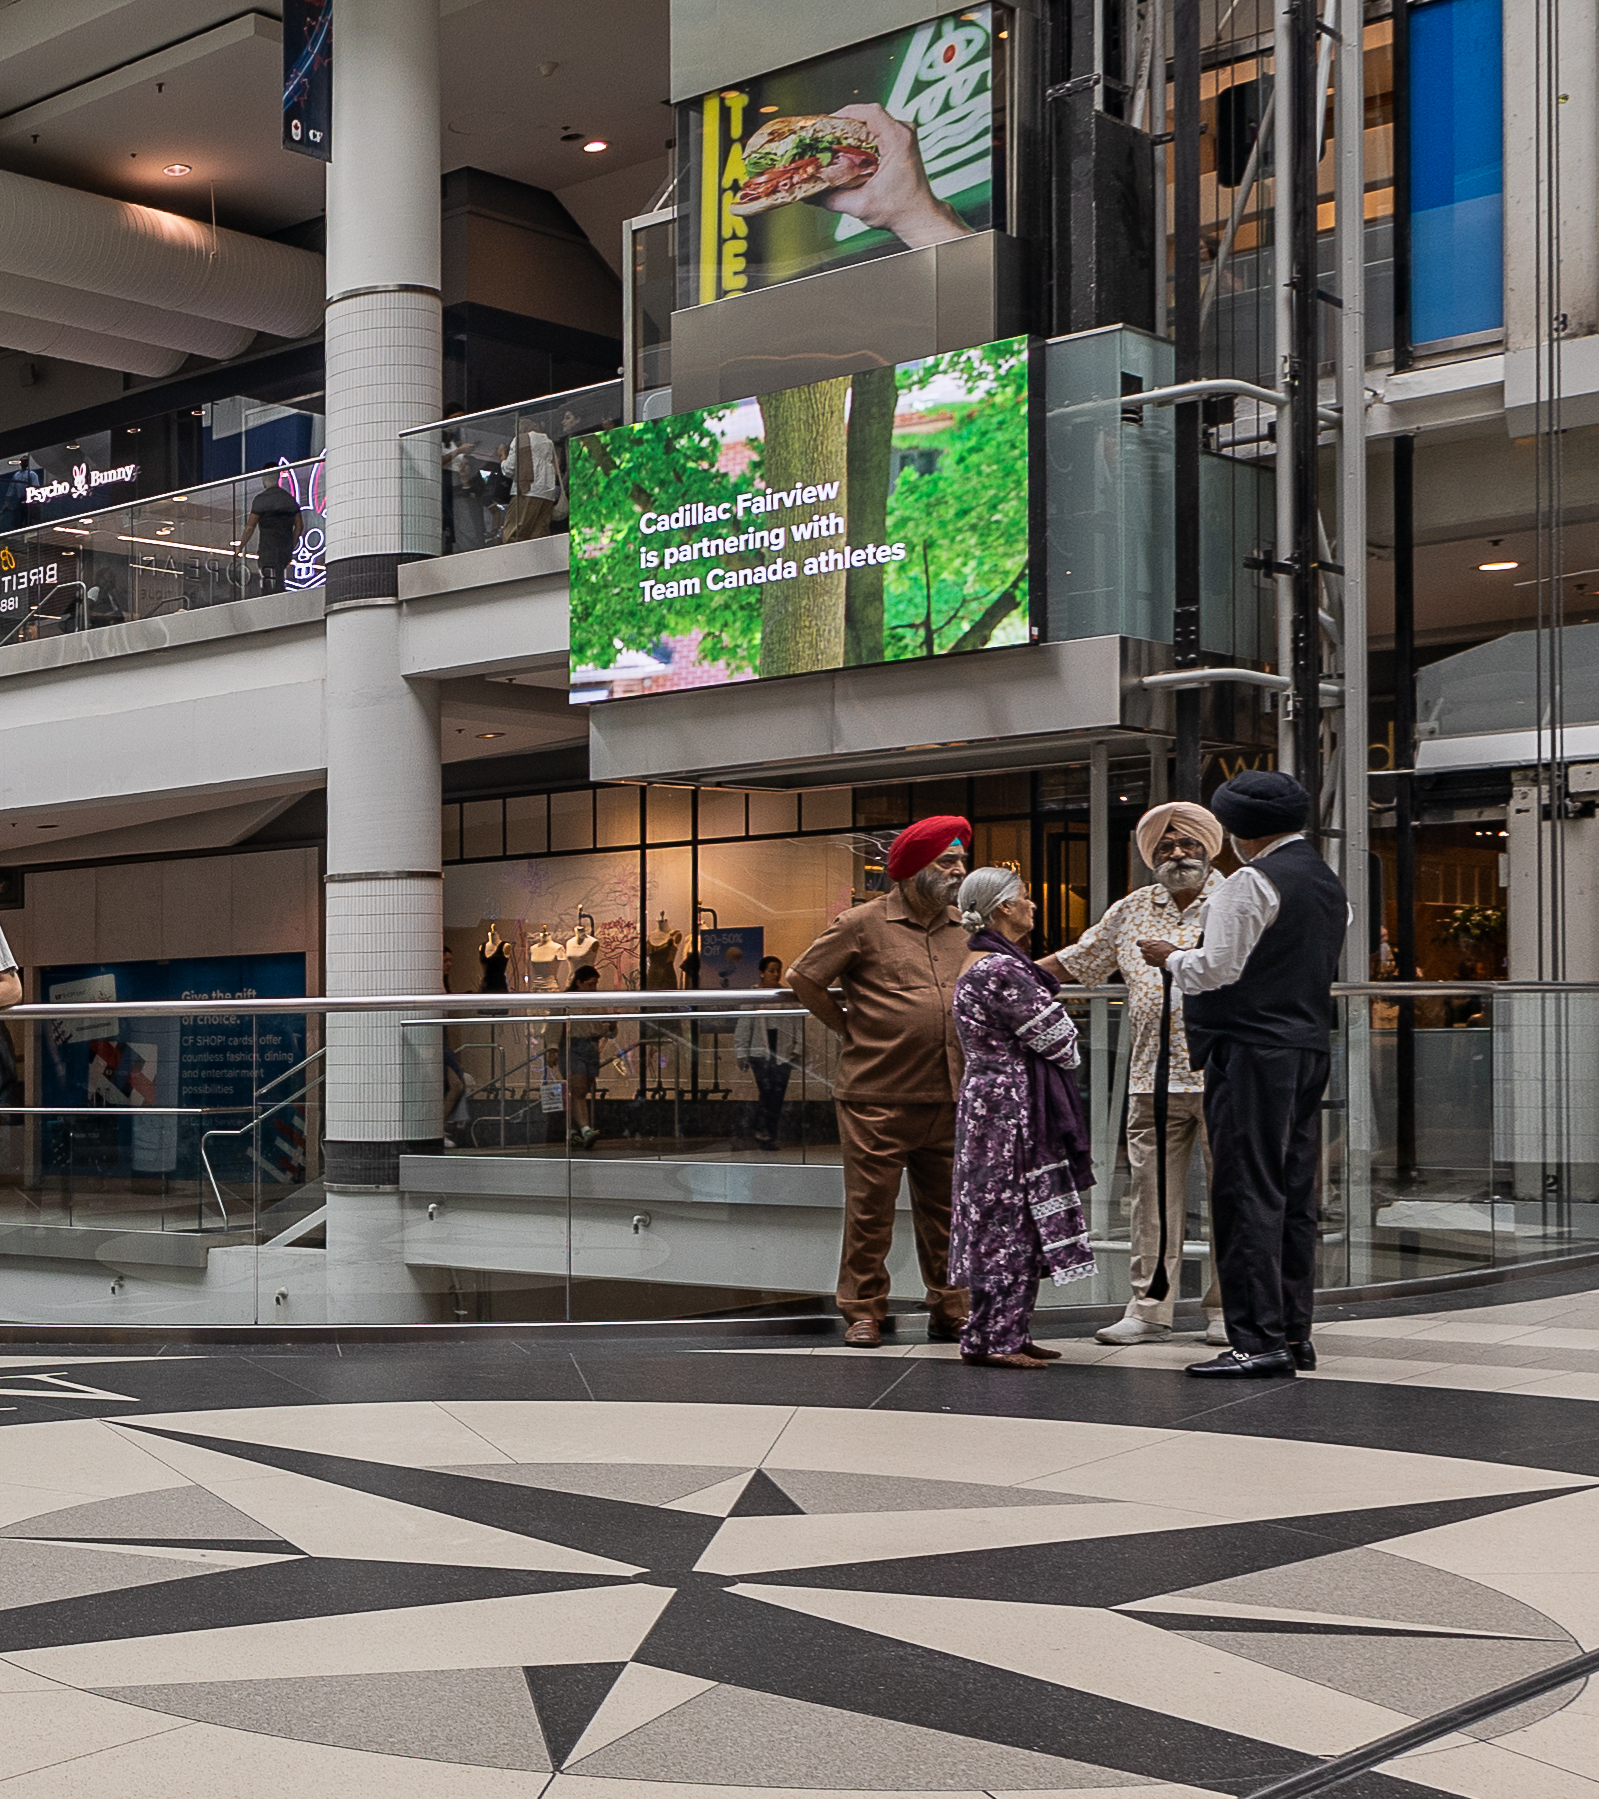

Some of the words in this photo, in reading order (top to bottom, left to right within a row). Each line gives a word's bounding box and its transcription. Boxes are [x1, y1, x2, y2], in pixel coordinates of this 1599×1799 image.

[309, 129, 323, 143] CF
[721, 93, 749, 299] TAKE
[26, 480, 70, 504] Psycho
[90, 463, 137, 486] Bunny
[639, 501, 732, 535] Cadillac
[736, 480, 840, 520] Fairview
[639, 546, 659, 569] is
[663, 526, 786, 570] partnering
[790, 513, 845, 542] with
[639, 576, 701, 602] Team
[706, 557, 798, 591] Canada
[803, 541, 906, 576] athletes
[181, 990, 209, 1001] Give
[211, 989, 232, 1000] the
[234, 987, 257, 999] gift
[182, 1014, 194, 1025] of
[197, 1014, 241, 1025] choice.
[182, 1035, 194, 1046] CF
[196, 1035, 227, 1046] SHOP!
[259, 1034, 282, 1045] offer
[182, 1052, 224, 1063] countless
[264, 1051, 294, 1063] dining
[182, 1068, 199, 1078] and
[182, 1083, 234, 1096] possibilities
